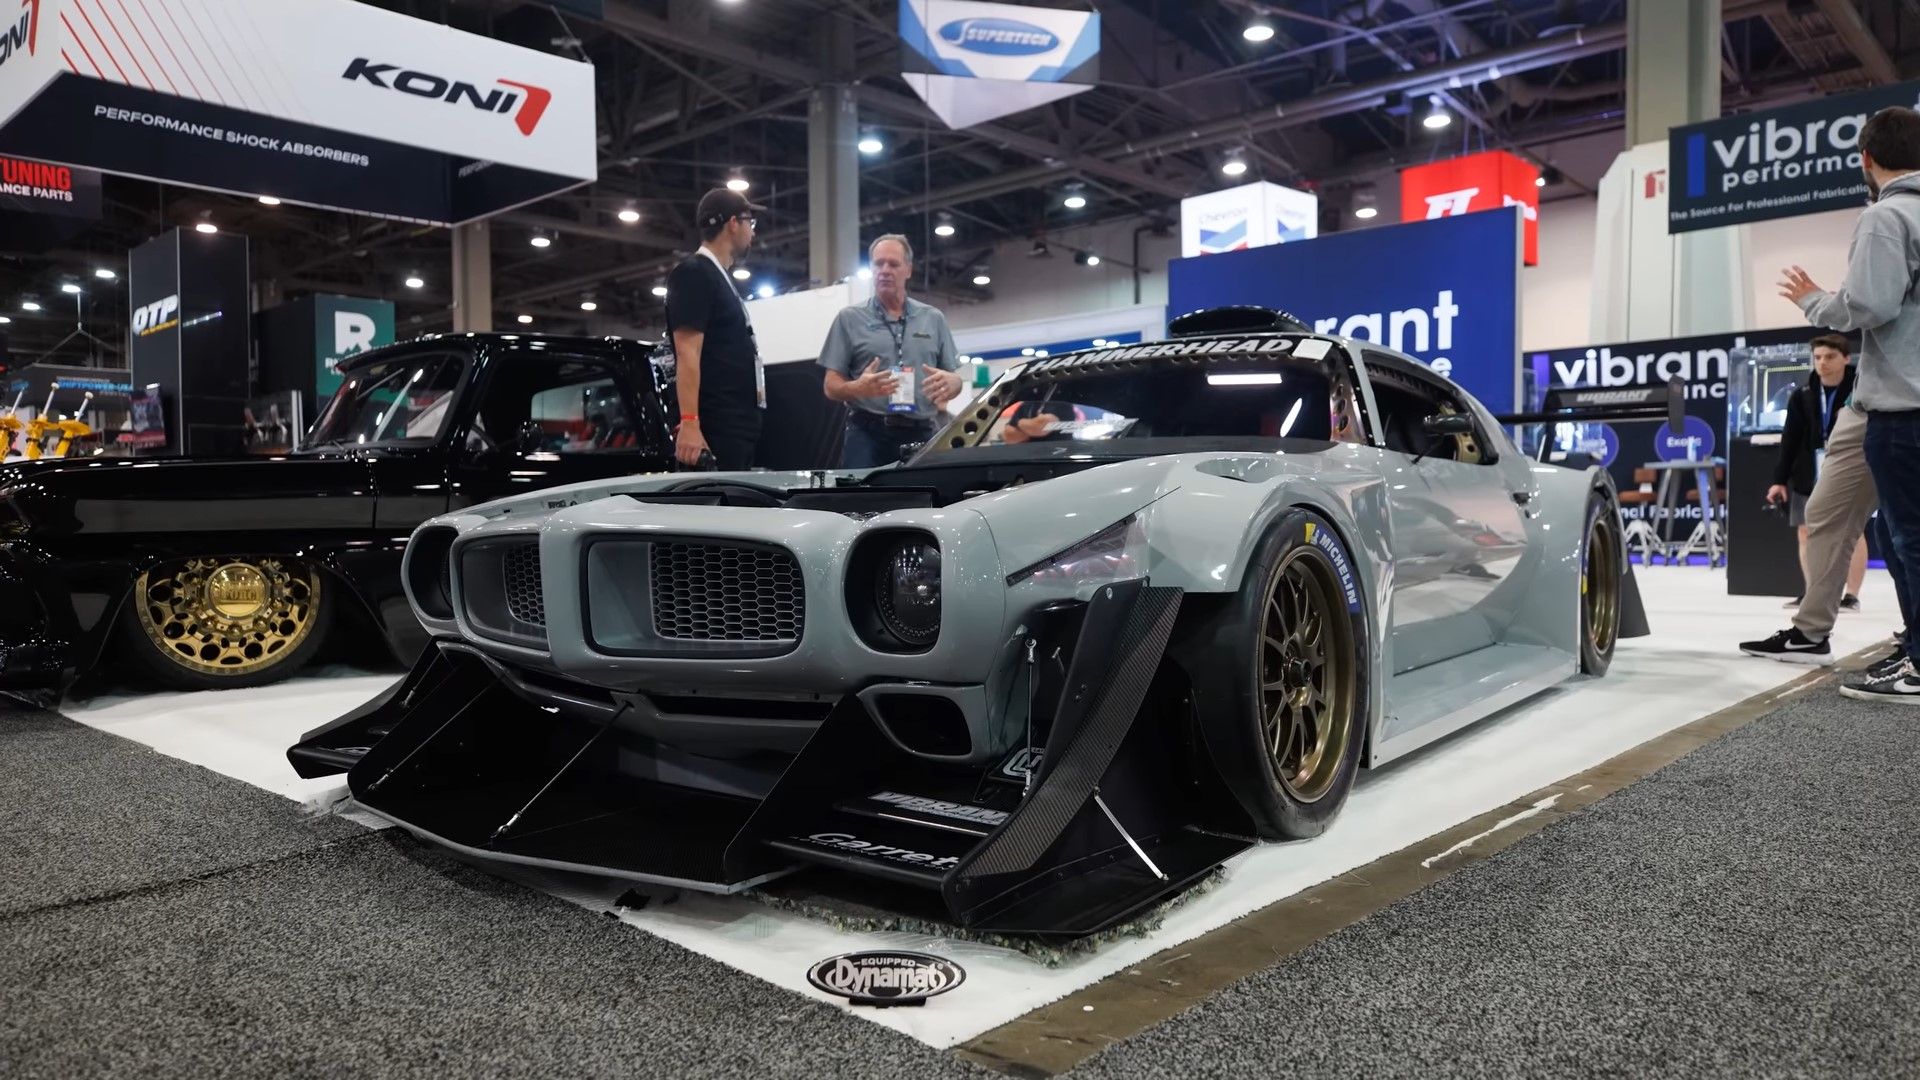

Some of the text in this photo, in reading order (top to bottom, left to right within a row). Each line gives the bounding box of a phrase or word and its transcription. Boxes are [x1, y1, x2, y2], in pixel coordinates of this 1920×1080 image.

[94, 104, 370, 167] PERFORMANCE SHOCK ABSORBERS
[1713, 113, 1868, 169] vibra
[0, 158, 71, 190] UNING
[33, 187, 74, 202] PARTS
[1670, 210, 1688, 222] The
[1690, 203, 1725, 217] Source
[1727, 202, 1744, 213] For
[1747, 191, 1811, 210] Professional
[1314, 290, 1459, 353] rant
[1027, 339, 1294, 373] HAMMERHEAD
[1554, 337, 1746, 387] vibran
[1319, 533, 1357, 605] MICHELIN
[808, 833, 959, 866] Garret
[835, 958, 938, 993] Dynamat
[860, 957, 917, 967] EQUIPPED
